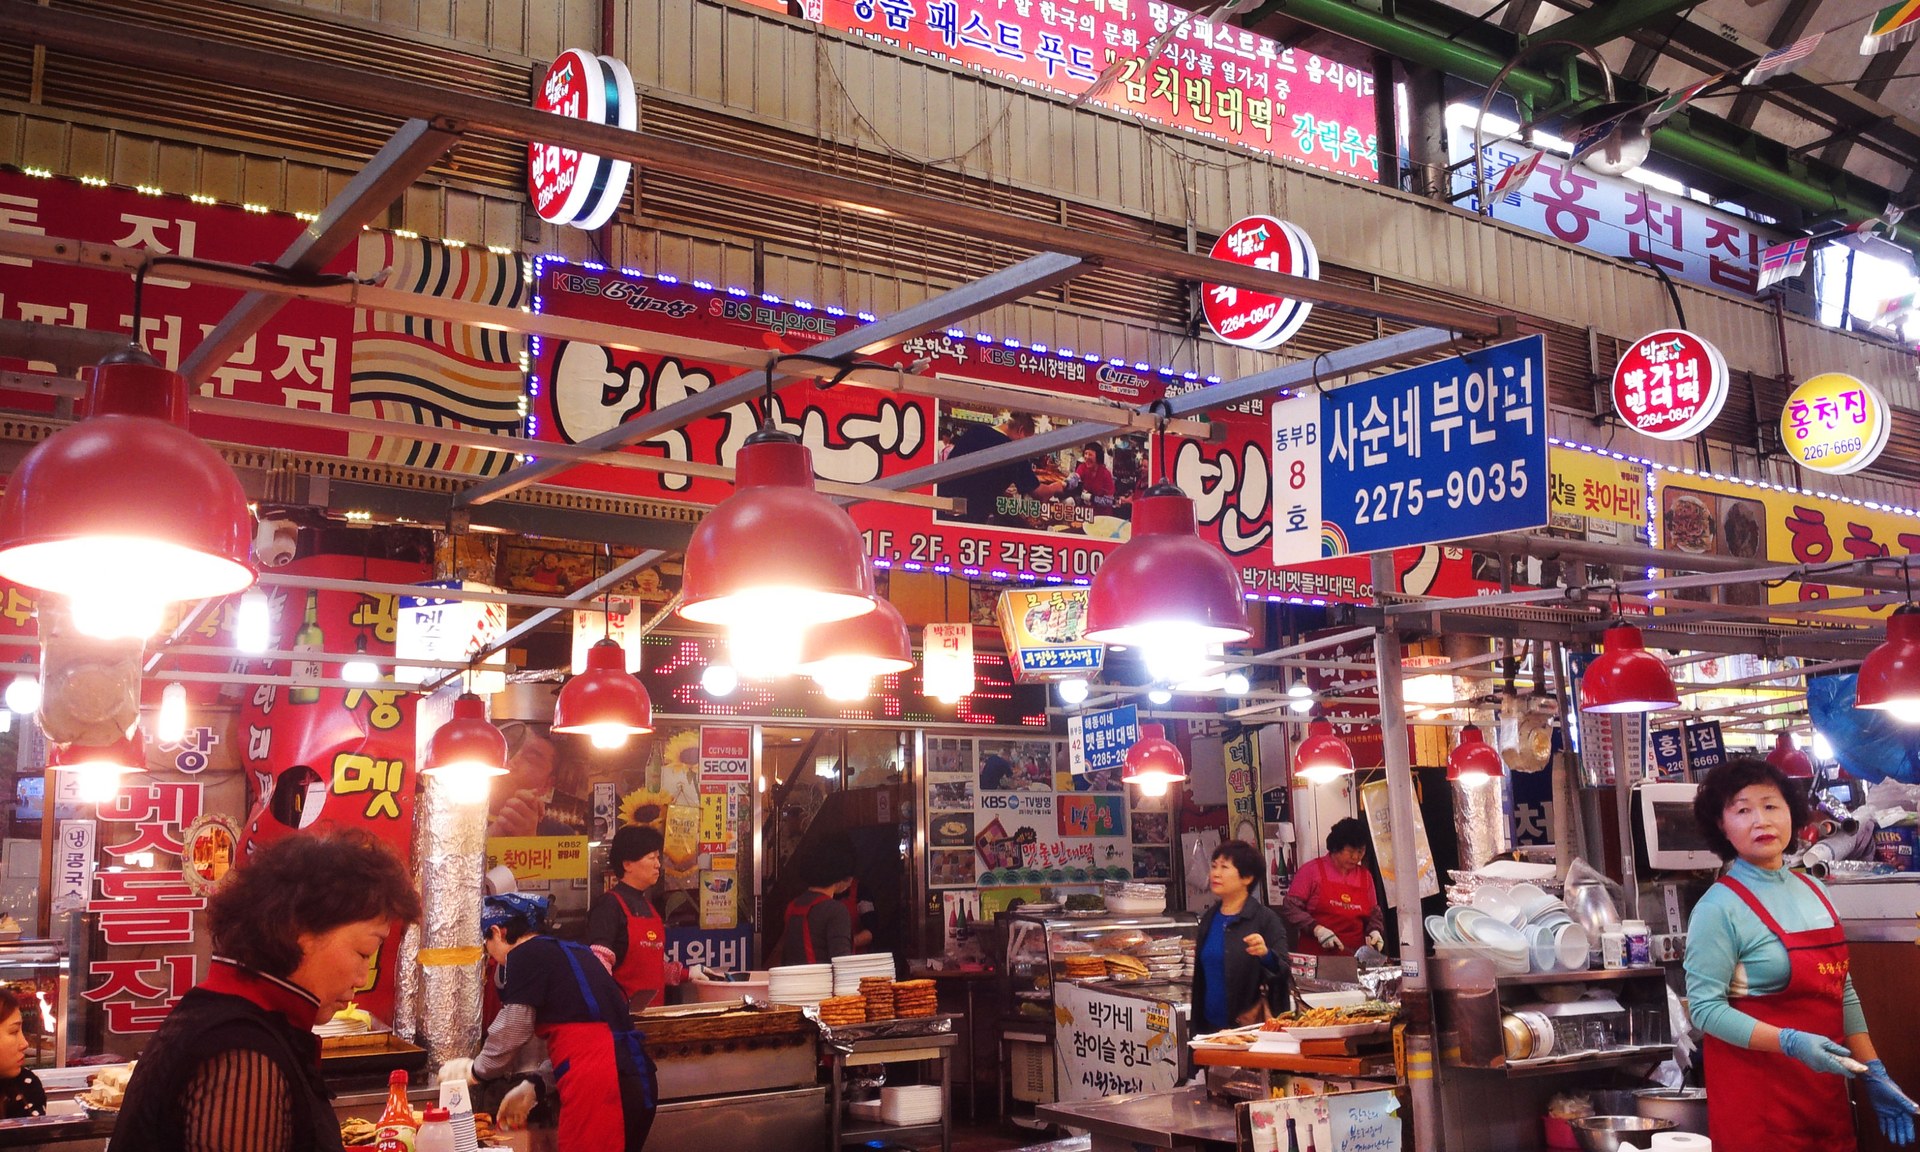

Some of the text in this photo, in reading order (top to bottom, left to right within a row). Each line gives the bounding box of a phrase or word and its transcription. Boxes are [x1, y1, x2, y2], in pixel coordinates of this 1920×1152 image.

[926, 0, 1026, 62] 패스트
[1034, 30, 1100, 82] 푸드
[1039, 3, 1096, 39] 한국의
[1102, 22, 1140, 52] 문화
[1221, 61, 1269, 94] 열가지
[1274, 77, 1292, 100] 중
[552, 271, 600, 296] KBS
[708, 297, 836, 337] SBS 모닝와이드
[1220, 303, 1276, 335] 2264-0847
[980, 347, 1016, 366] KBS
[1018, 353, 1087, 383] 우수시장박람회
[1623, 358, 1699, 391] 박가네
[1624, 380, 1700, 414] 빈대떡
[1328, 386, 1421, 472] 사순네
[1636, 406, 1697, 428] 2264-0847
[1788, 388, 1868, 441] 홍천집
[1276, 422, 1318, 452] 동부B
[1803, 437, 1863, 462] 2267-6669
[1289, 460, 1306, 490] 8
[1355, 458, 1529, 525] 2275-9035
[1582, 478, 1641, 520] 찾아라!
[996, 496, 1095, 524] 광장시장의 명물인데
[1286, 504, 1308, 534] 호
[958, 538, 991, 567] 3F
[1072, 739, 1081, 751] 42
[703, 760, 747, 773] SECOM
[1666, 753, 1720, 772] 226-6669
[981, 795, 1008, 809] KBS
[1274, 805, 1282, 820] 7
[503, 848, 552, 871] 찾아라!
[1088, 1001, 1133, 1033] 박가네
[1073, 1030, 1152, 1067] 참이슬 창고
